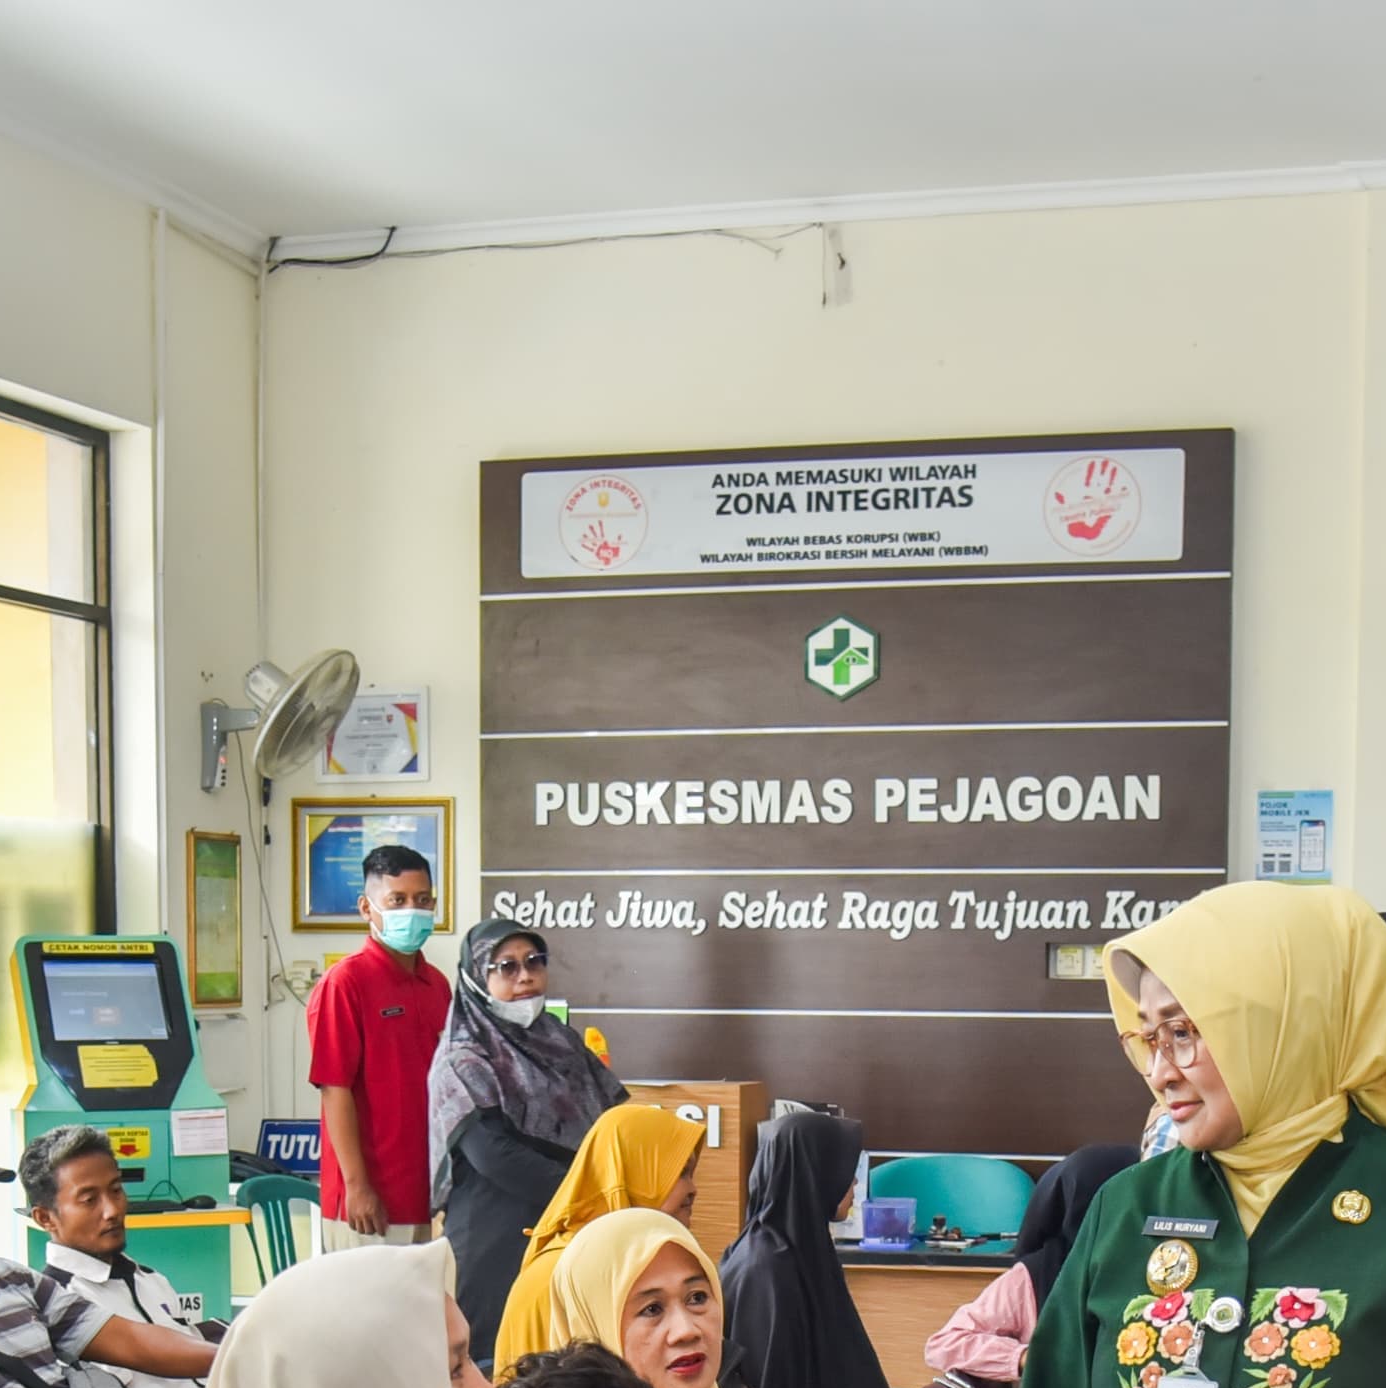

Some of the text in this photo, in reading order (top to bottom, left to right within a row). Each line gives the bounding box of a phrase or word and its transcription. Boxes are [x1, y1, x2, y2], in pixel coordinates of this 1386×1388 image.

[712, 464, 977, 489] ANDA MEMASUKI WILAYAH
[715, 485, 974, 516] ZONA INTEGRITAS
[746, 531, 941, 548] WILAYAH BEBAS KORUPSI (WBK)
[700, 545, 989, 564] WILAYAH BIROKRASI BERSIH MELAYANI (WBBM)
[535, 775, 1161, 827] PUSKESMAS PEJAGOAN
[491, 890, 596, 930] Sehat
[605, 890, 709, 937] Jiwa,
[718, 890, 829, 930] Sehat
[837, 890, 939, 940] Raga
[948, 890, 1091, 940] Tujuan
[267, 1134, 321, 1160] TUTU
[1154, 1221, 1207, 1234] LILIS NURYANI
